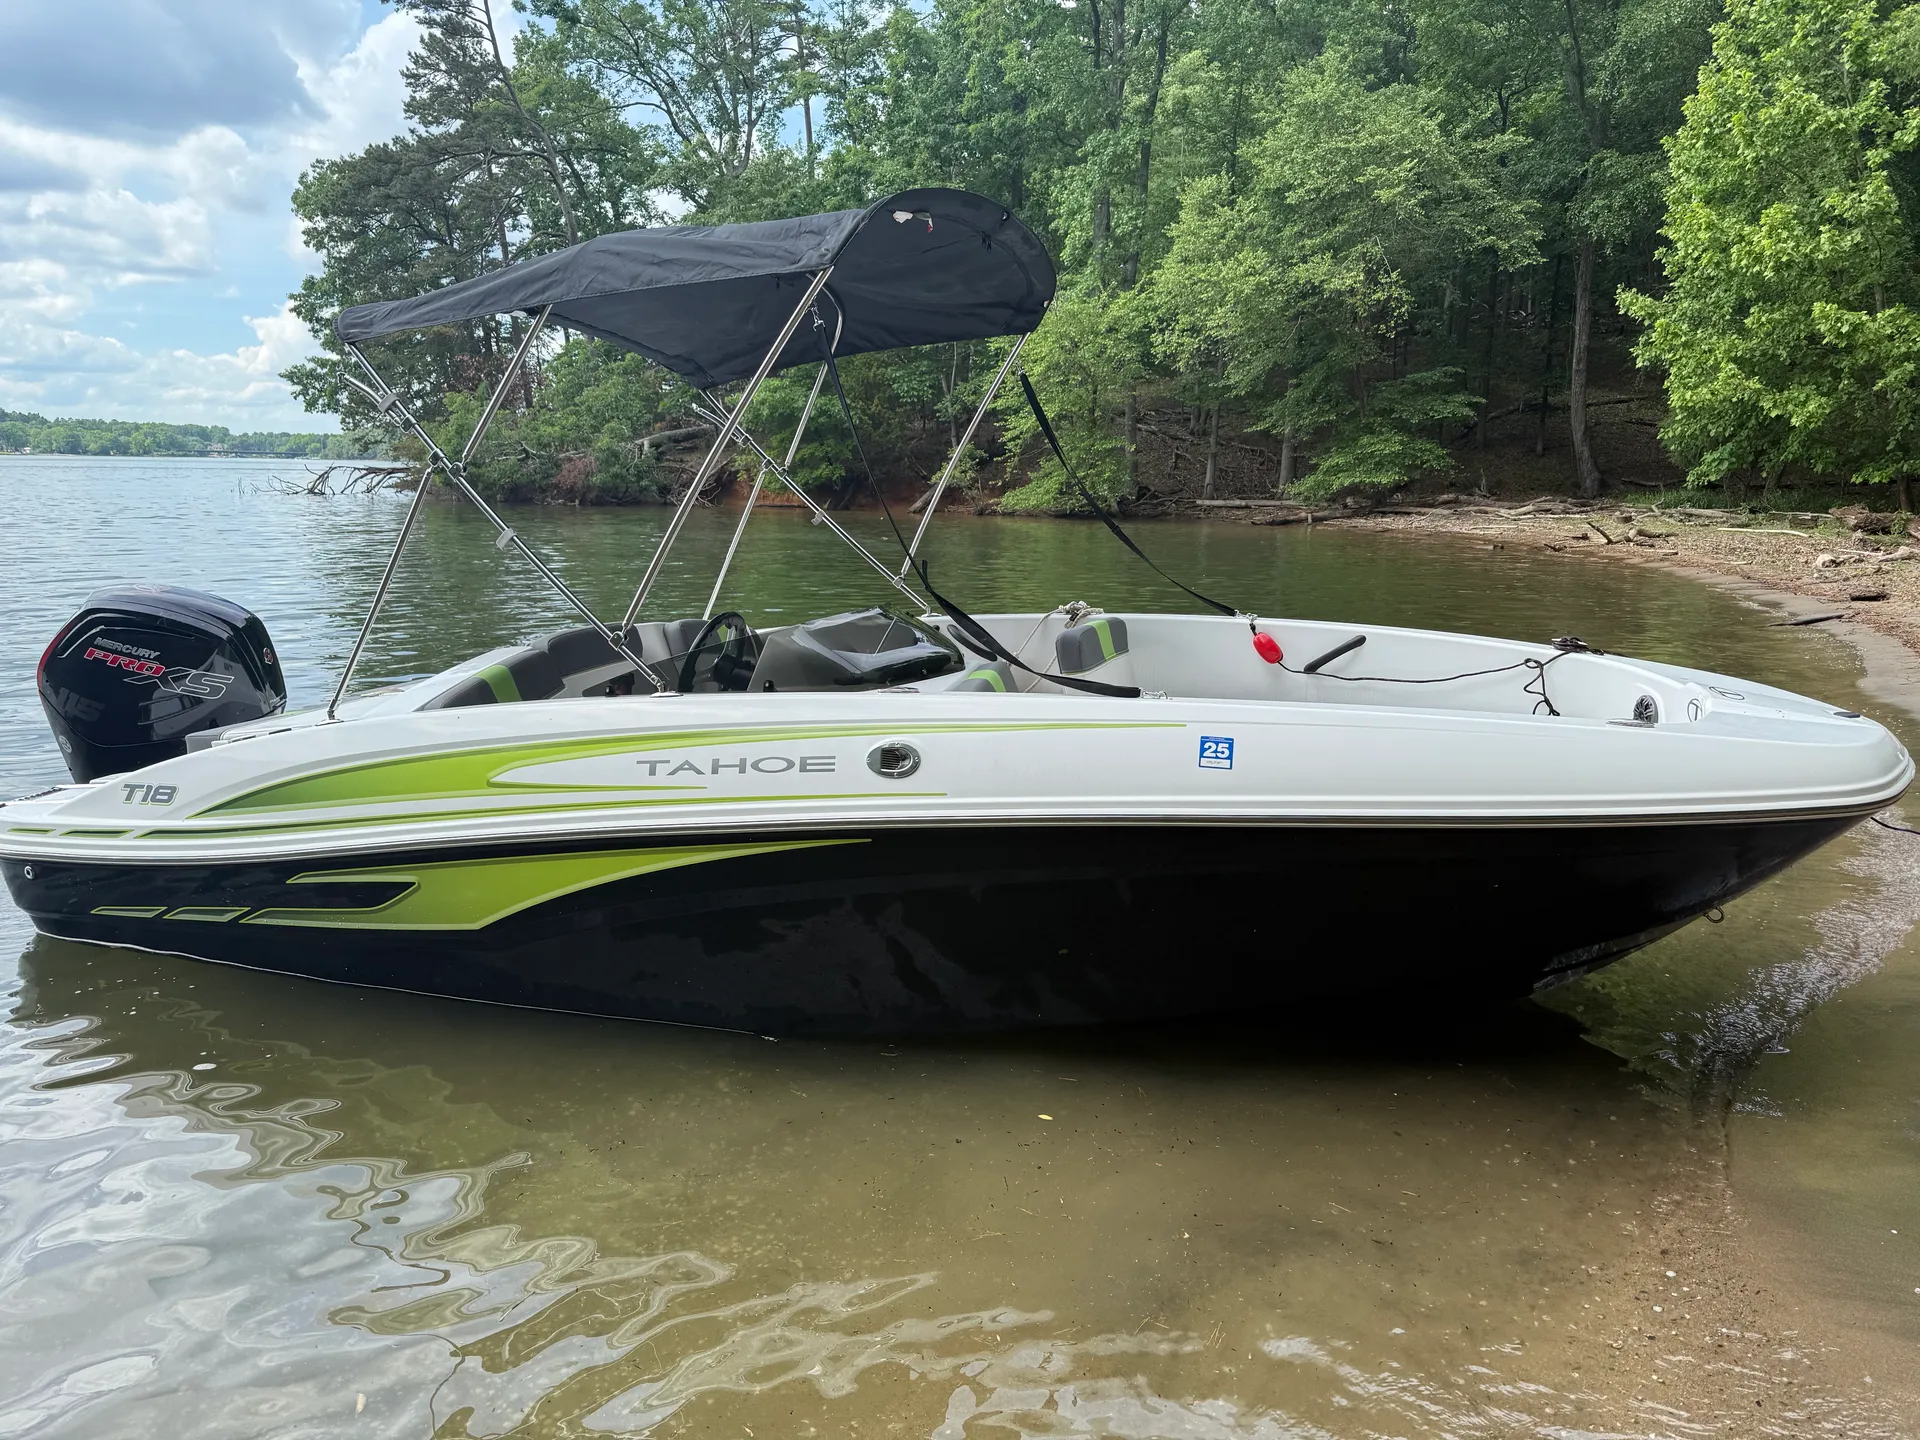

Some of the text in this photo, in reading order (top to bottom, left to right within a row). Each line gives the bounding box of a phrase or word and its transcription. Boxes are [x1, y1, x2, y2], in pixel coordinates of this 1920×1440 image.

[94, 637, 161, 659] MERCURY
[84, 647, 234, 699] PRO XS
[1203, 742, 1230, 758] 25
[636, 755, 836, 776] TAHOE
[121, 782, 179, 806] T18
